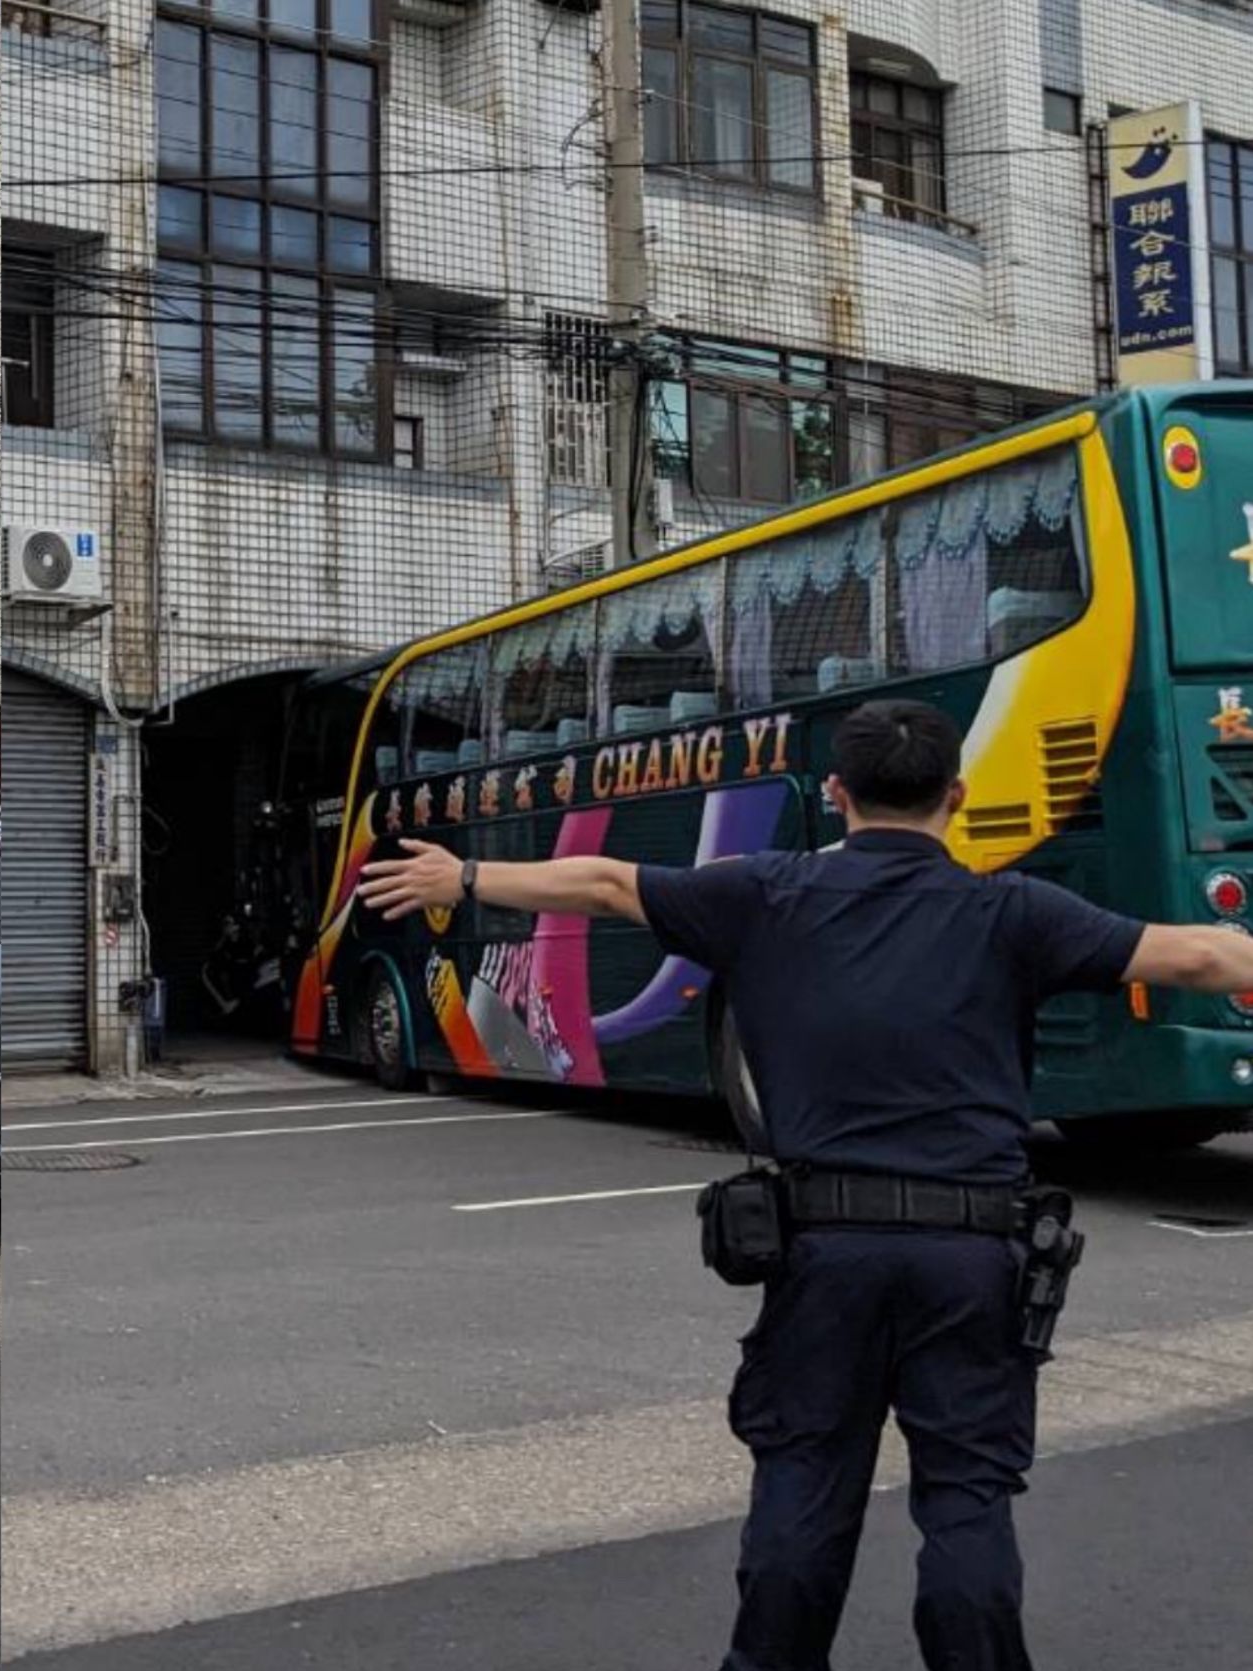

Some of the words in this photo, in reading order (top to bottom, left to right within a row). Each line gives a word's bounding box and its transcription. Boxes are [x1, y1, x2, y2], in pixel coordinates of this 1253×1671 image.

[1120, 325, 1193, 347] udn.com
[592, 725, 724, 800] CHANG
[742, 712, 792, 777] YI
